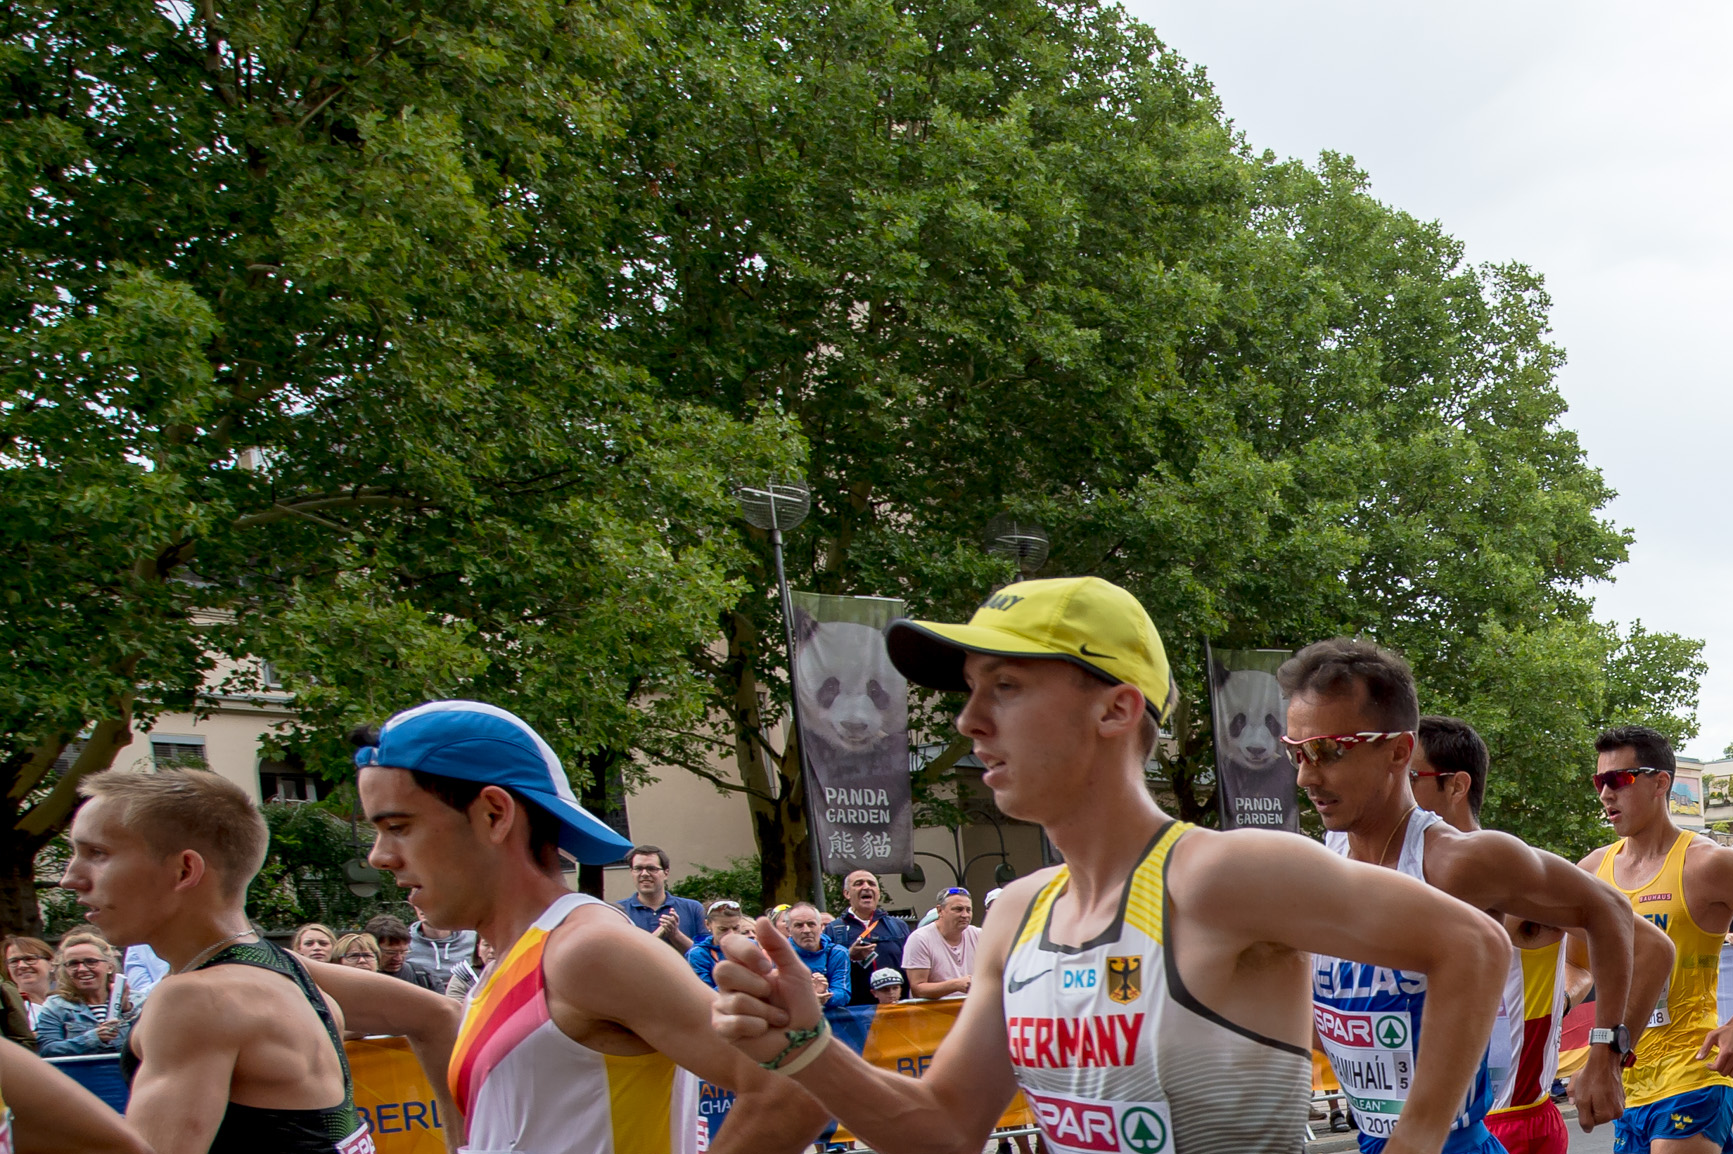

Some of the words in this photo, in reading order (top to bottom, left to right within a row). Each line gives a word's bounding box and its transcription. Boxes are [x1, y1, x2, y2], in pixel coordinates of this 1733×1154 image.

[824, 787, 890, 806] PANDA
[1234, 797, 1283, 811] PANDA
[825, 808, 891, 824] GARDEN
[1235, 813, 1284, 825] GARDEN
[828, 830, 892, 859] 熊貓
[1063, 969, 1097, 988] DKB
[1312, 957, 1428, 999] ELLAS
[1315, 1010, 1371, 1044] SPAR
[1649, 1012, 1664, 1024] 18
[1008, 1013, 1145, 1069] GERMANY
[700, 1100, 736, 1115] CHA
